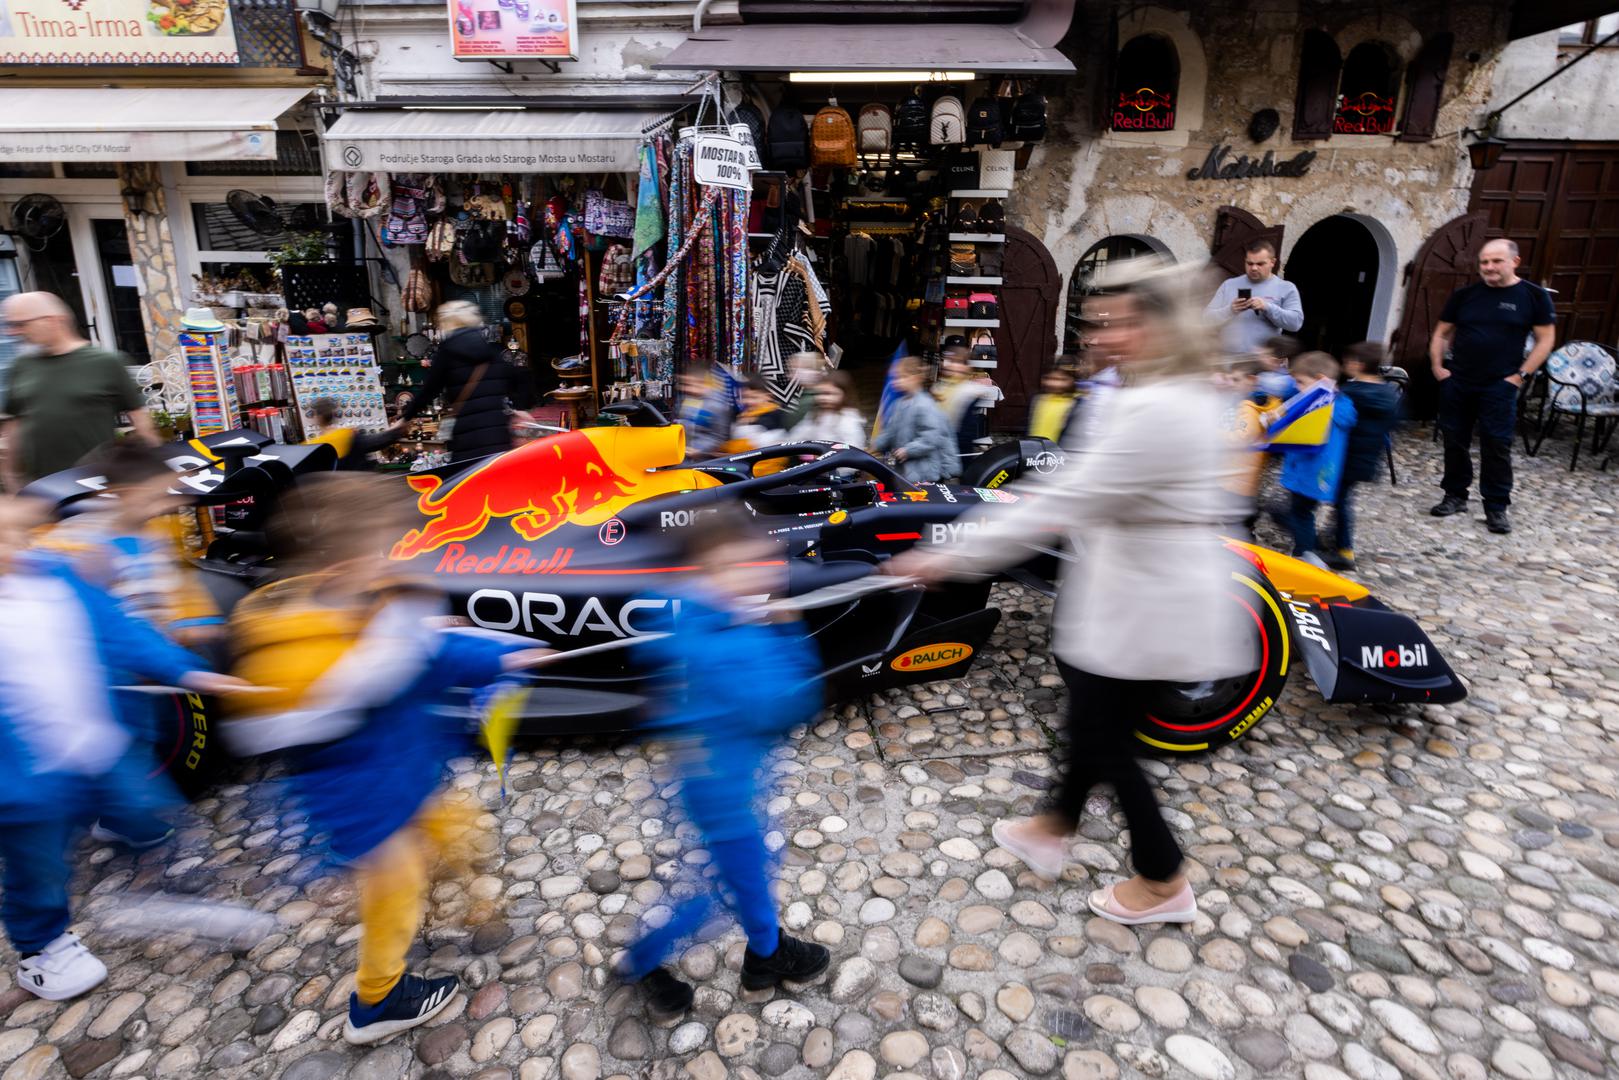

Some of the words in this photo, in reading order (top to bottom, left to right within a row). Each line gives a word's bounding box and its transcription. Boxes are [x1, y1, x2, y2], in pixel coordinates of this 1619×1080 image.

[15, 11, 142, 37] Tima-Irma
[1113, 111, 1143, 129] Red
[1145, 111, 1174, 129] Bull
[1335, 116, 1364, 133] Red
[16, 144, 34, 153] Area
[60, 144, 73, 153] Old
[75, 144, 90, 154] City
[103, 144, 131, 153] Mostar
[701, 146, 738, 164] MOSTAR
[380, 154, 419, 165] Područje
[421, 154, 455, 165] Staroga
[456, 154, 483, 164] Grada
[485, 154, 501, 164] oko
[503, 154, 537, 166] Staroga
[539, 154, 567, 164] Mosta
[578, 154, 616, 164] Mostaru
[717, 164, 742, 180] 100%
[1026, 457, 1046, 467] Hard
[1046, 456, 1065, 467] Rock
[434, 542, 509, 575] Red
[498, 546, 575, 575] Bull
[912, 647, 964, 666] RAUCH
[1360, 643, 1429, 669] Mobil
[186, 690, 208, 770] ZERO
